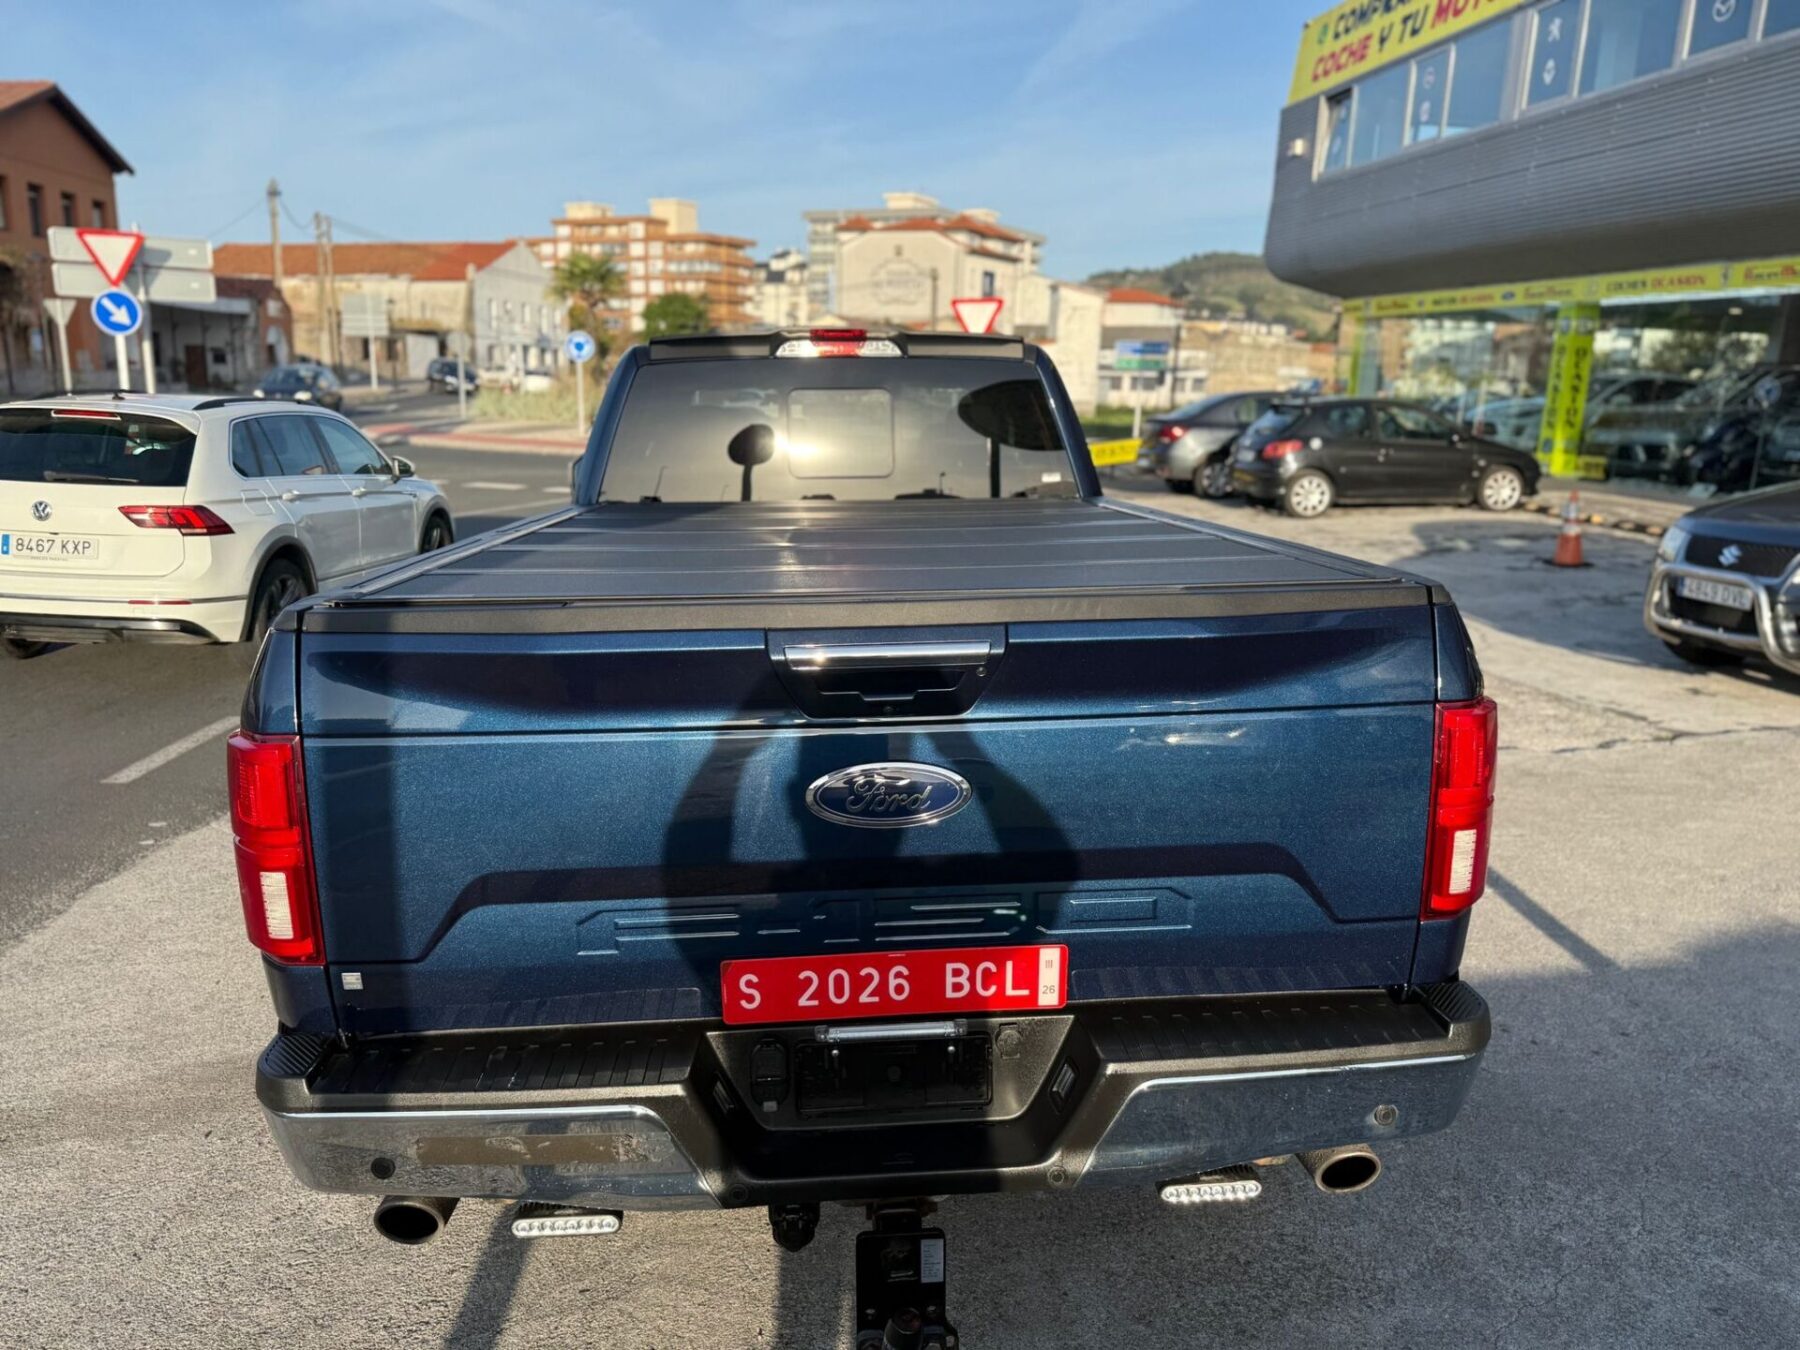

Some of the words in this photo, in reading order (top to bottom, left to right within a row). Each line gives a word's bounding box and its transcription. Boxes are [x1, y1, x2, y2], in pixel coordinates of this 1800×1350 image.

[1312, 33, 1373, 82] COCHE
[1399, 5, 1429, 43] TU
[15, 537, 56, 554] 8467
[60, 539, 92, 555] KXP
[845, 777, 933, 813] Ford
[739, 973, 762, 1010] S
[798, 965, 911, 1008] 2026
[945, 960, 1031, 999] BCL
[1042, 984, 1056, 995] 26
